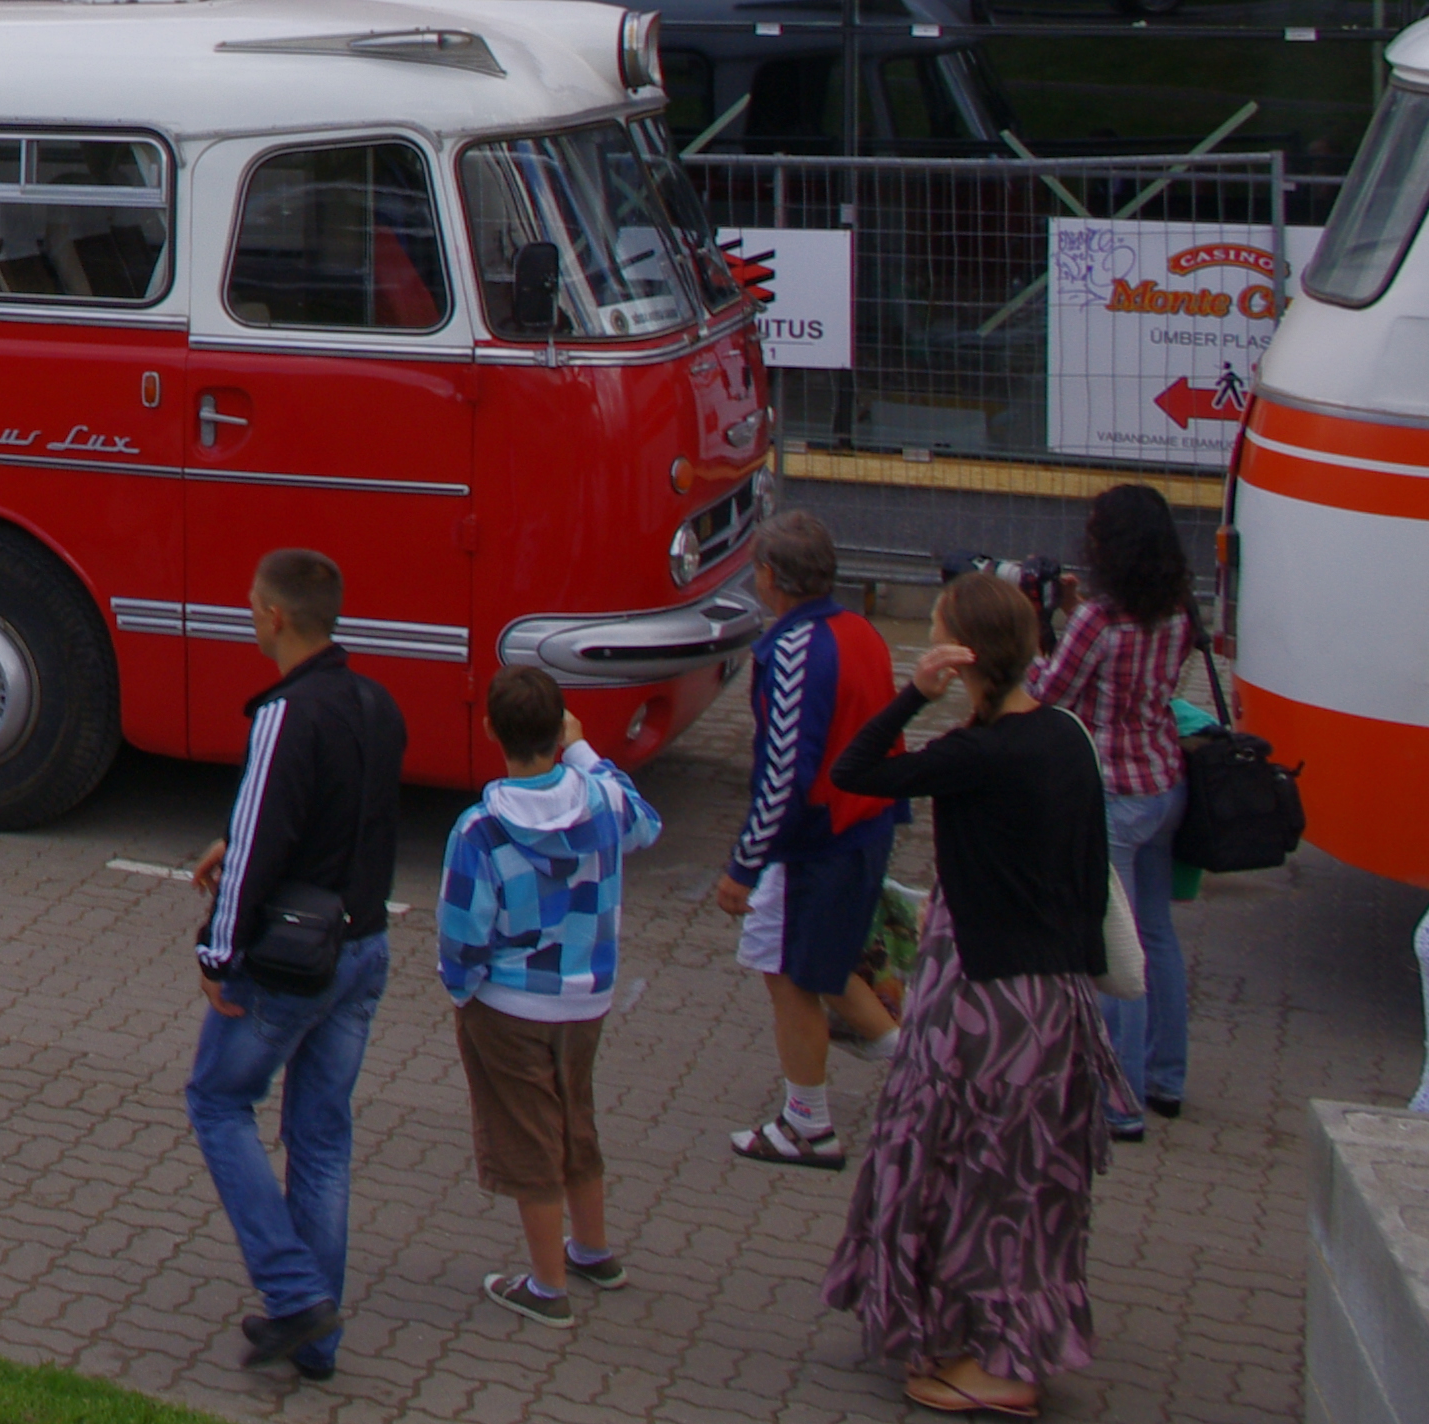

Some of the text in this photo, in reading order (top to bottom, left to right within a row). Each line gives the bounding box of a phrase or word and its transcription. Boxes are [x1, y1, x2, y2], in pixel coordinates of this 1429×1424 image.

[1180, 248, 1274, 270] CASINO
[1106, 278, 1232, 317] Monte
[758, 318, 823, 339] ITUS
[1150, 327, 1218, 347] ÜMBER
[47, 425, 140, 454] Lux
